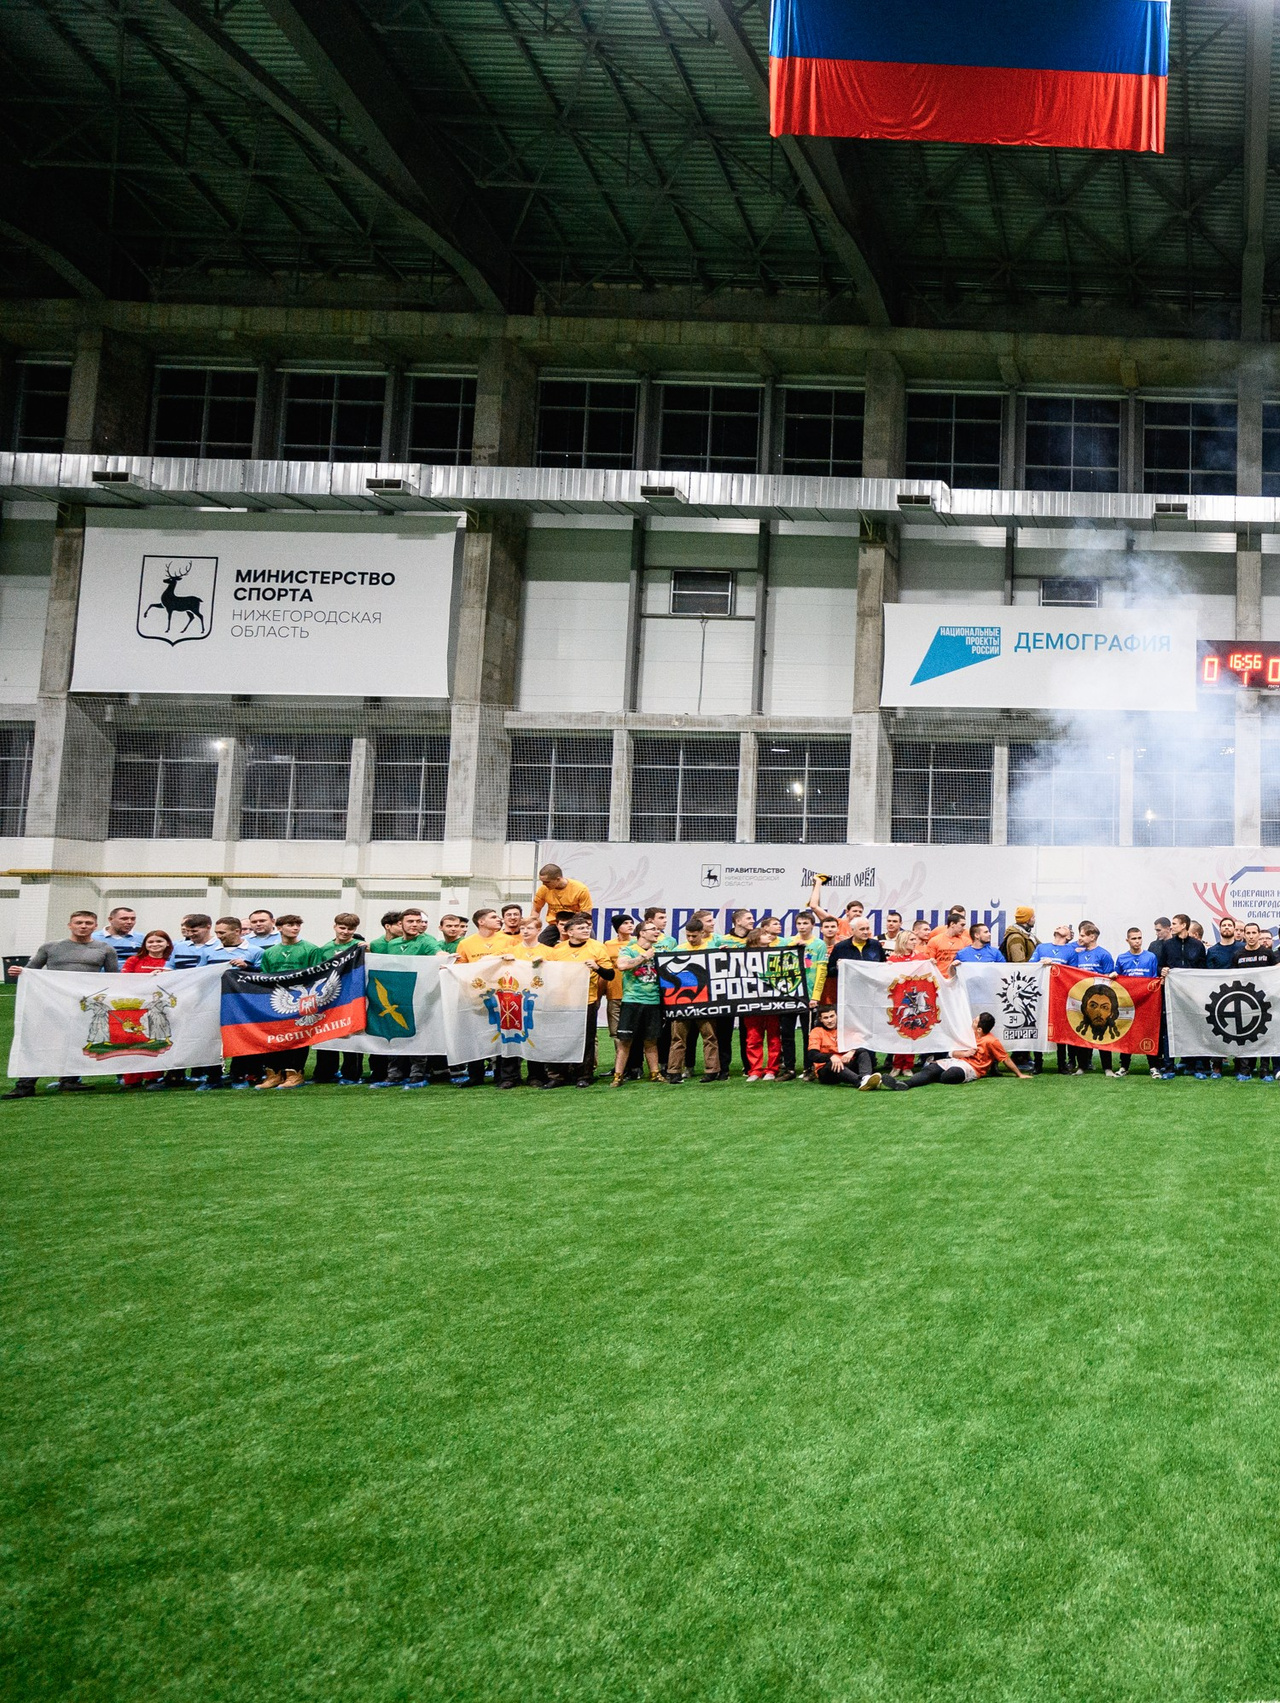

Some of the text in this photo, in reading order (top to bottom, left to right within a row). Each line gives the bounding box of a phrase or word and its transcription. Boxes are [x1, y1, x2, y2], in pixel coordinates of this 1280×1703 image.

[235, 569, 396, 586] МИНИСТЕРСТВО
[233, 587, 313, 603] СПОРТА
[232, 609, 382, 625] НИЖЕГОРОДСКАЯ
[230, 625, 310, 639] ОБЛАСТЬ
[940, 627, 1000, 637] НАЦИОНАЛЬНЫЕ
[966, 636, 1000, 645] ПРОЕКТЫ
[1014, 632, 1171, 653] ДЕМОГРАФИЯ
[971, 645, 1000, 654] РОССИИ
[1204, 657, 1219, 681] 0
[1230, 654, 1262, 669] 16:56
[854, 867, 876, 887] ОРЁЛ
[1230, 889, 1275, 898] ФЕДЕРАЦИЯ
[1247, 910, 1280, 918] ОБЛАСТИ
[737, 1001, 807, 1012] ДРУЖБА
[267, 1017, 352, 1044] РЕСПУБЛИКА
